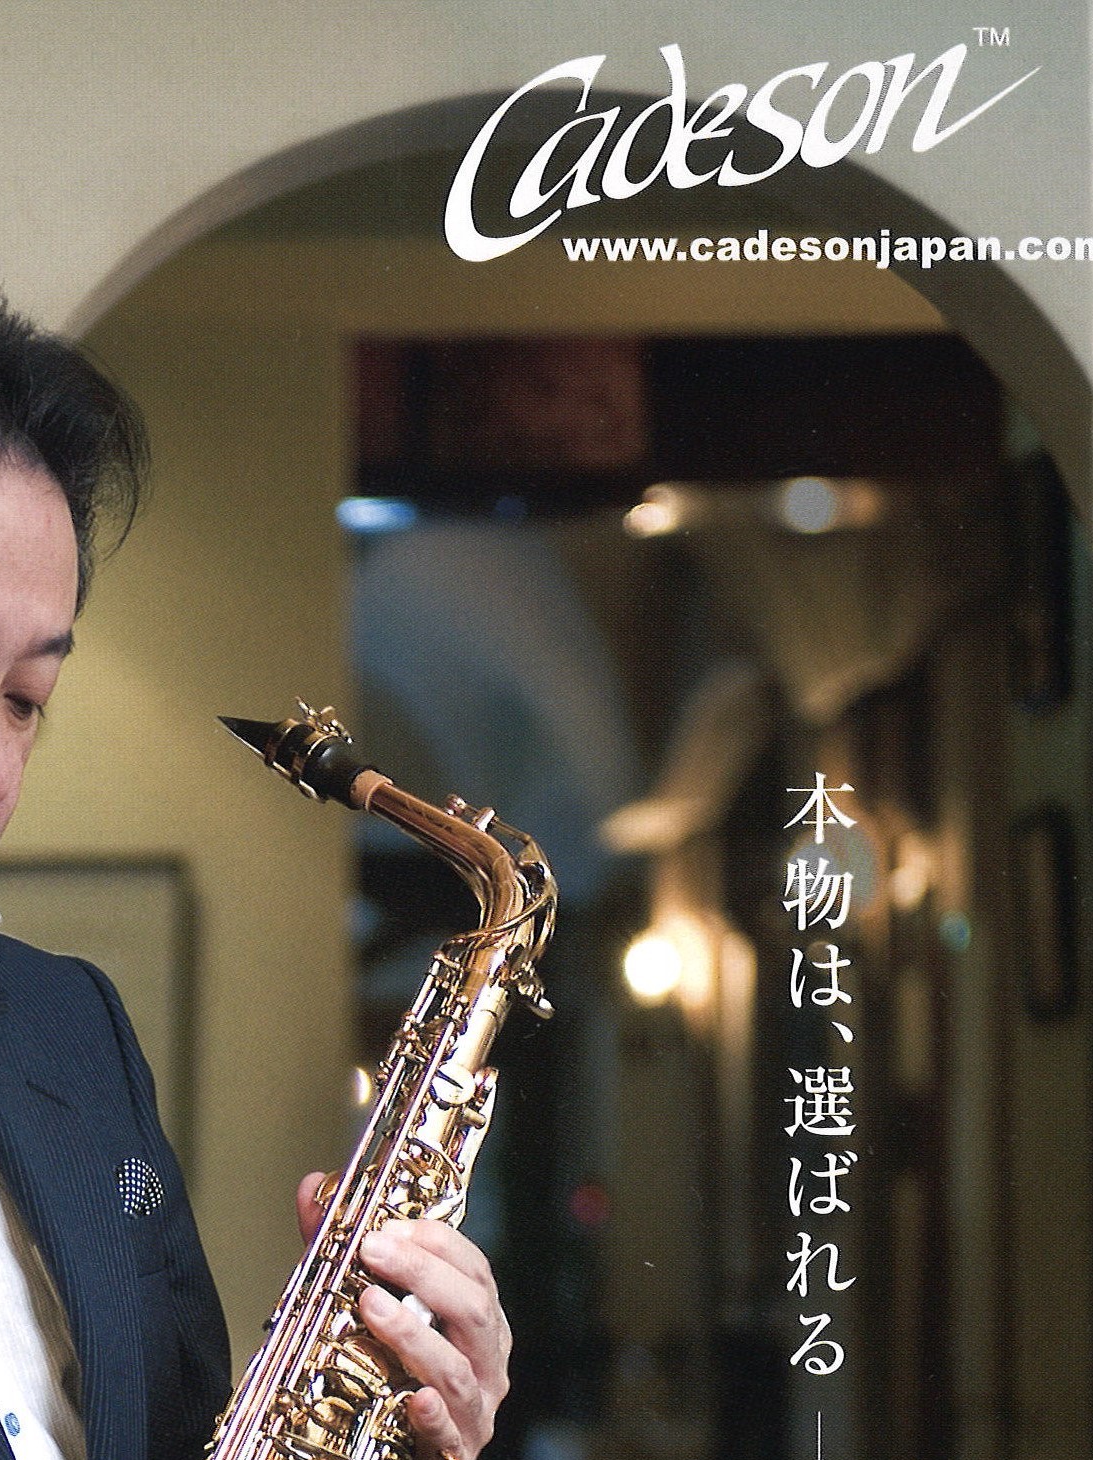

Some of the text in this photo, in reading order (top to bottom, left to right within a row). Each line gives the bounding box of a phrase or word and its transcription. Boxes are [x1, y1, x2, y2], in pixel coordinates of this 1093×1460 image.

[444, 43, 1042, 262] Cadeson
[782, 771, 858, 1375] 本物は、選ばれる
